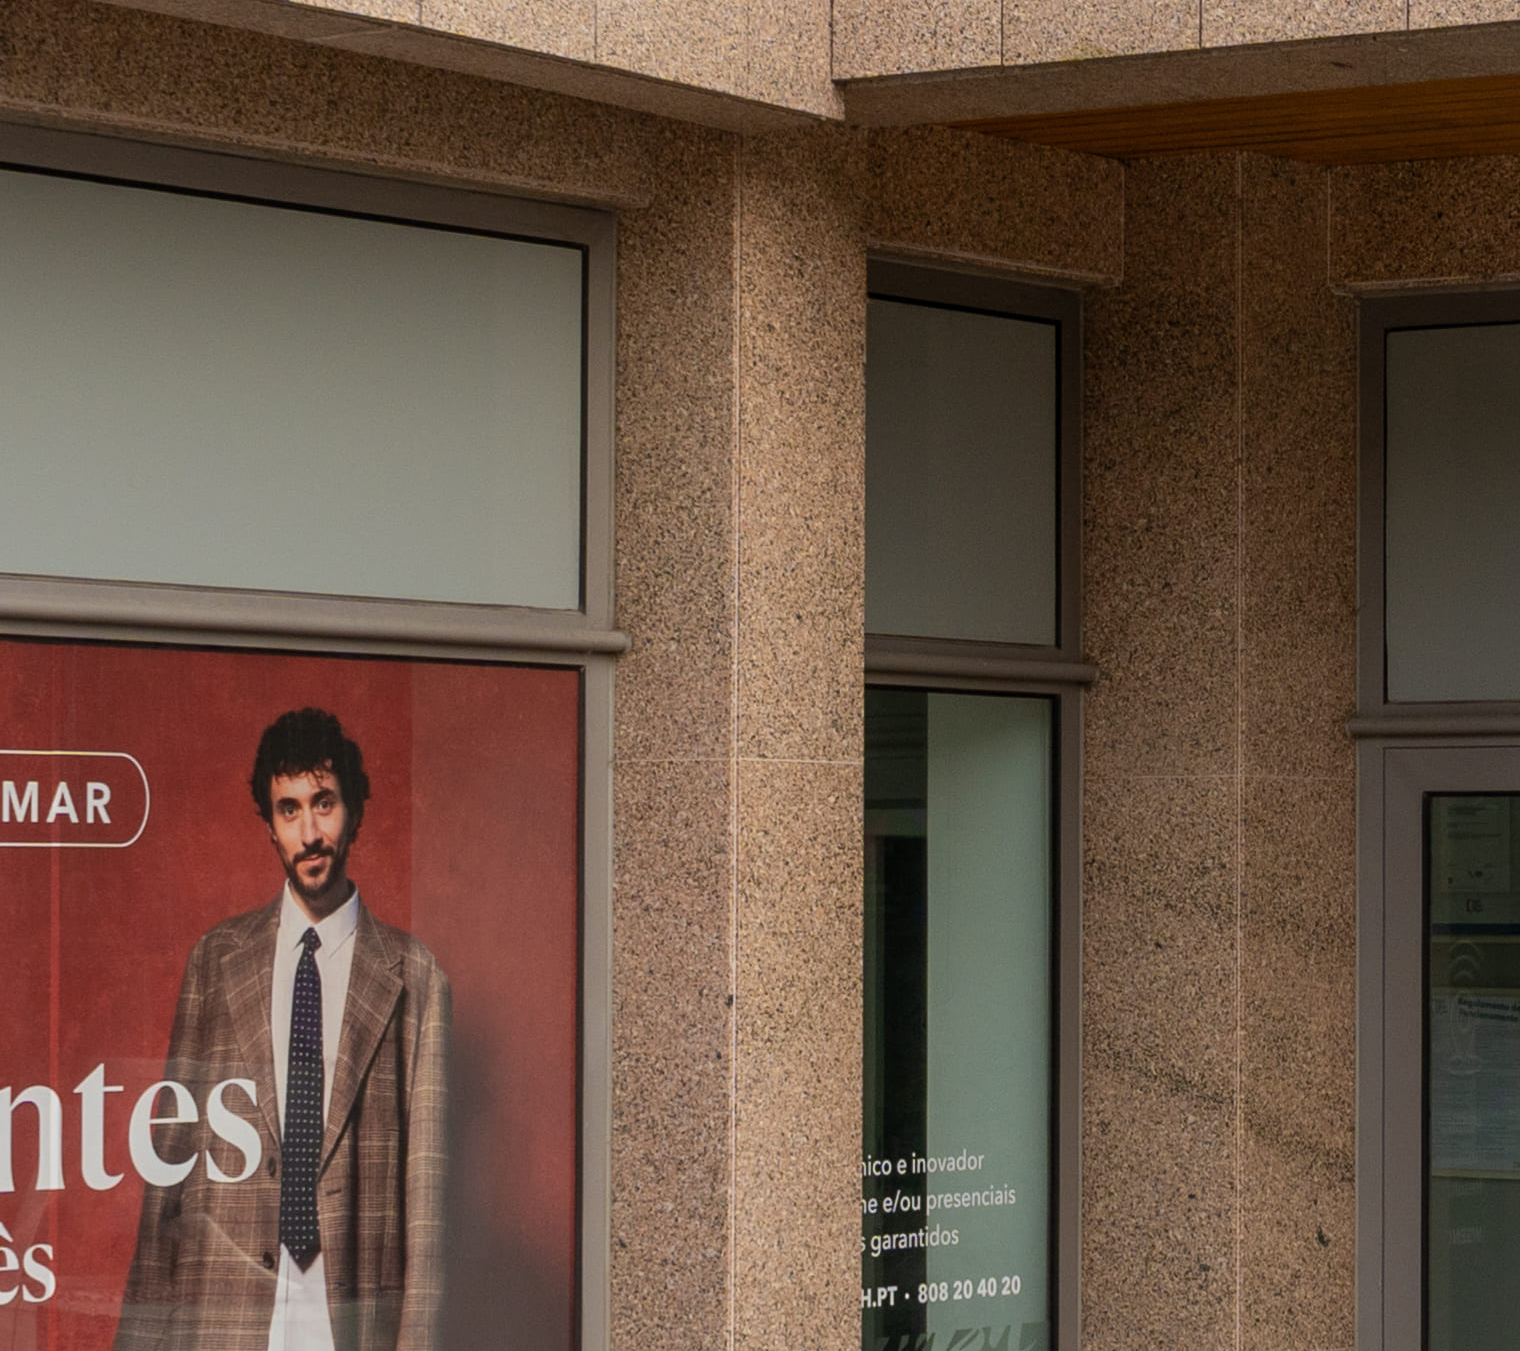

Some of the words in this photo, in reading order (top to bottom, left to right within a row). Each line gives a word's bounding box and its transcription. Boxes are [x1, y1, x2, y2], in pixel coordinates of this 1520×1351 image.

[897, 1158, 908, 1175] e
[912, 1149, 985, 1175] inovador
[883, 1189, 921, 1214] e/ou
[926, 1184, 1017, 1217] presenciais
[870, 1223, 960, 1258] garantidos
[917, 1282, 948, 1304] 808
[953, 1279, 973, 1300] 20
[977, 1277, 997, 1298] 40
[1001, 1275, 1021, 1296] 20
